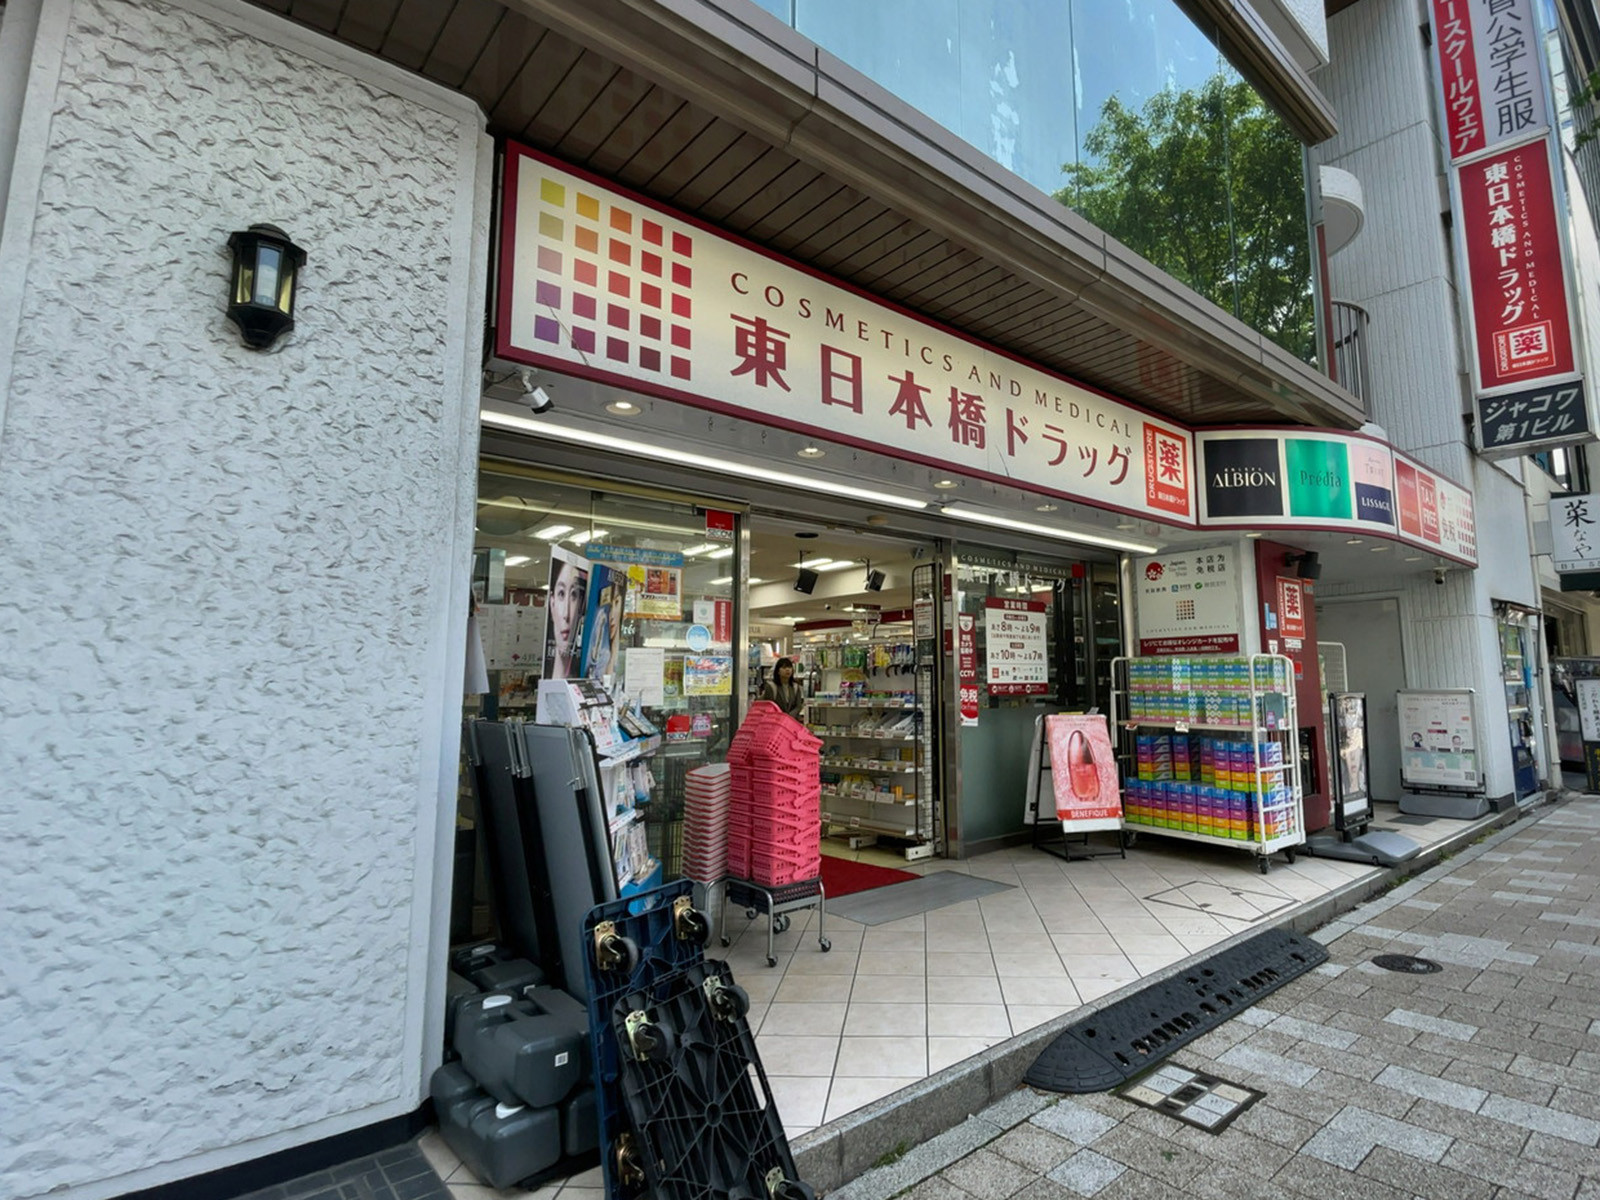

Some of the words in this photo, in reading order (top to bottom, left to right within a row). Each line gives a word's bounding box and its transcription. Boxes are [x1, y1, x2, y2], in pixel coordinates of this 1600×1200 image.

[1441, 0, 1479, 152] ースクールウェア
[1514, 156, 1529, 227] COSMETICS
[1484, 162, 1525, 325] 東日本橋ドラッグ
[1523, 232, 1533, 257] AND
[1526, 262, 1539, 319] MEDICAL
[730, 272, 953, 372] COSMETICS
[968, 365, 1022, 397] AND
[1035, 389, 1131, 438] MEDICAL
[1512, 329, 1543, 355] 薬
[730, 313, 1132, 486] 東日本橋ドラッグ
[1485, 388, 1579, 423] ジャコワ
[1494, 413, 1575, 442] 第1ビル
[1158, 439, 1182, 484] 薬
[1300, 470, 1342, 487] Prédia
[1420, 485, 1434, 505] TAX
[961, 554, 1012, 569] COSMETICS
[1015, 561, 1031, 571] AND
[1033, 565, 1067, 576] MEDICAL
[959, 669, 975, 678] CCTV
[1070, 808, 1109, 819] BENEFIQUE
